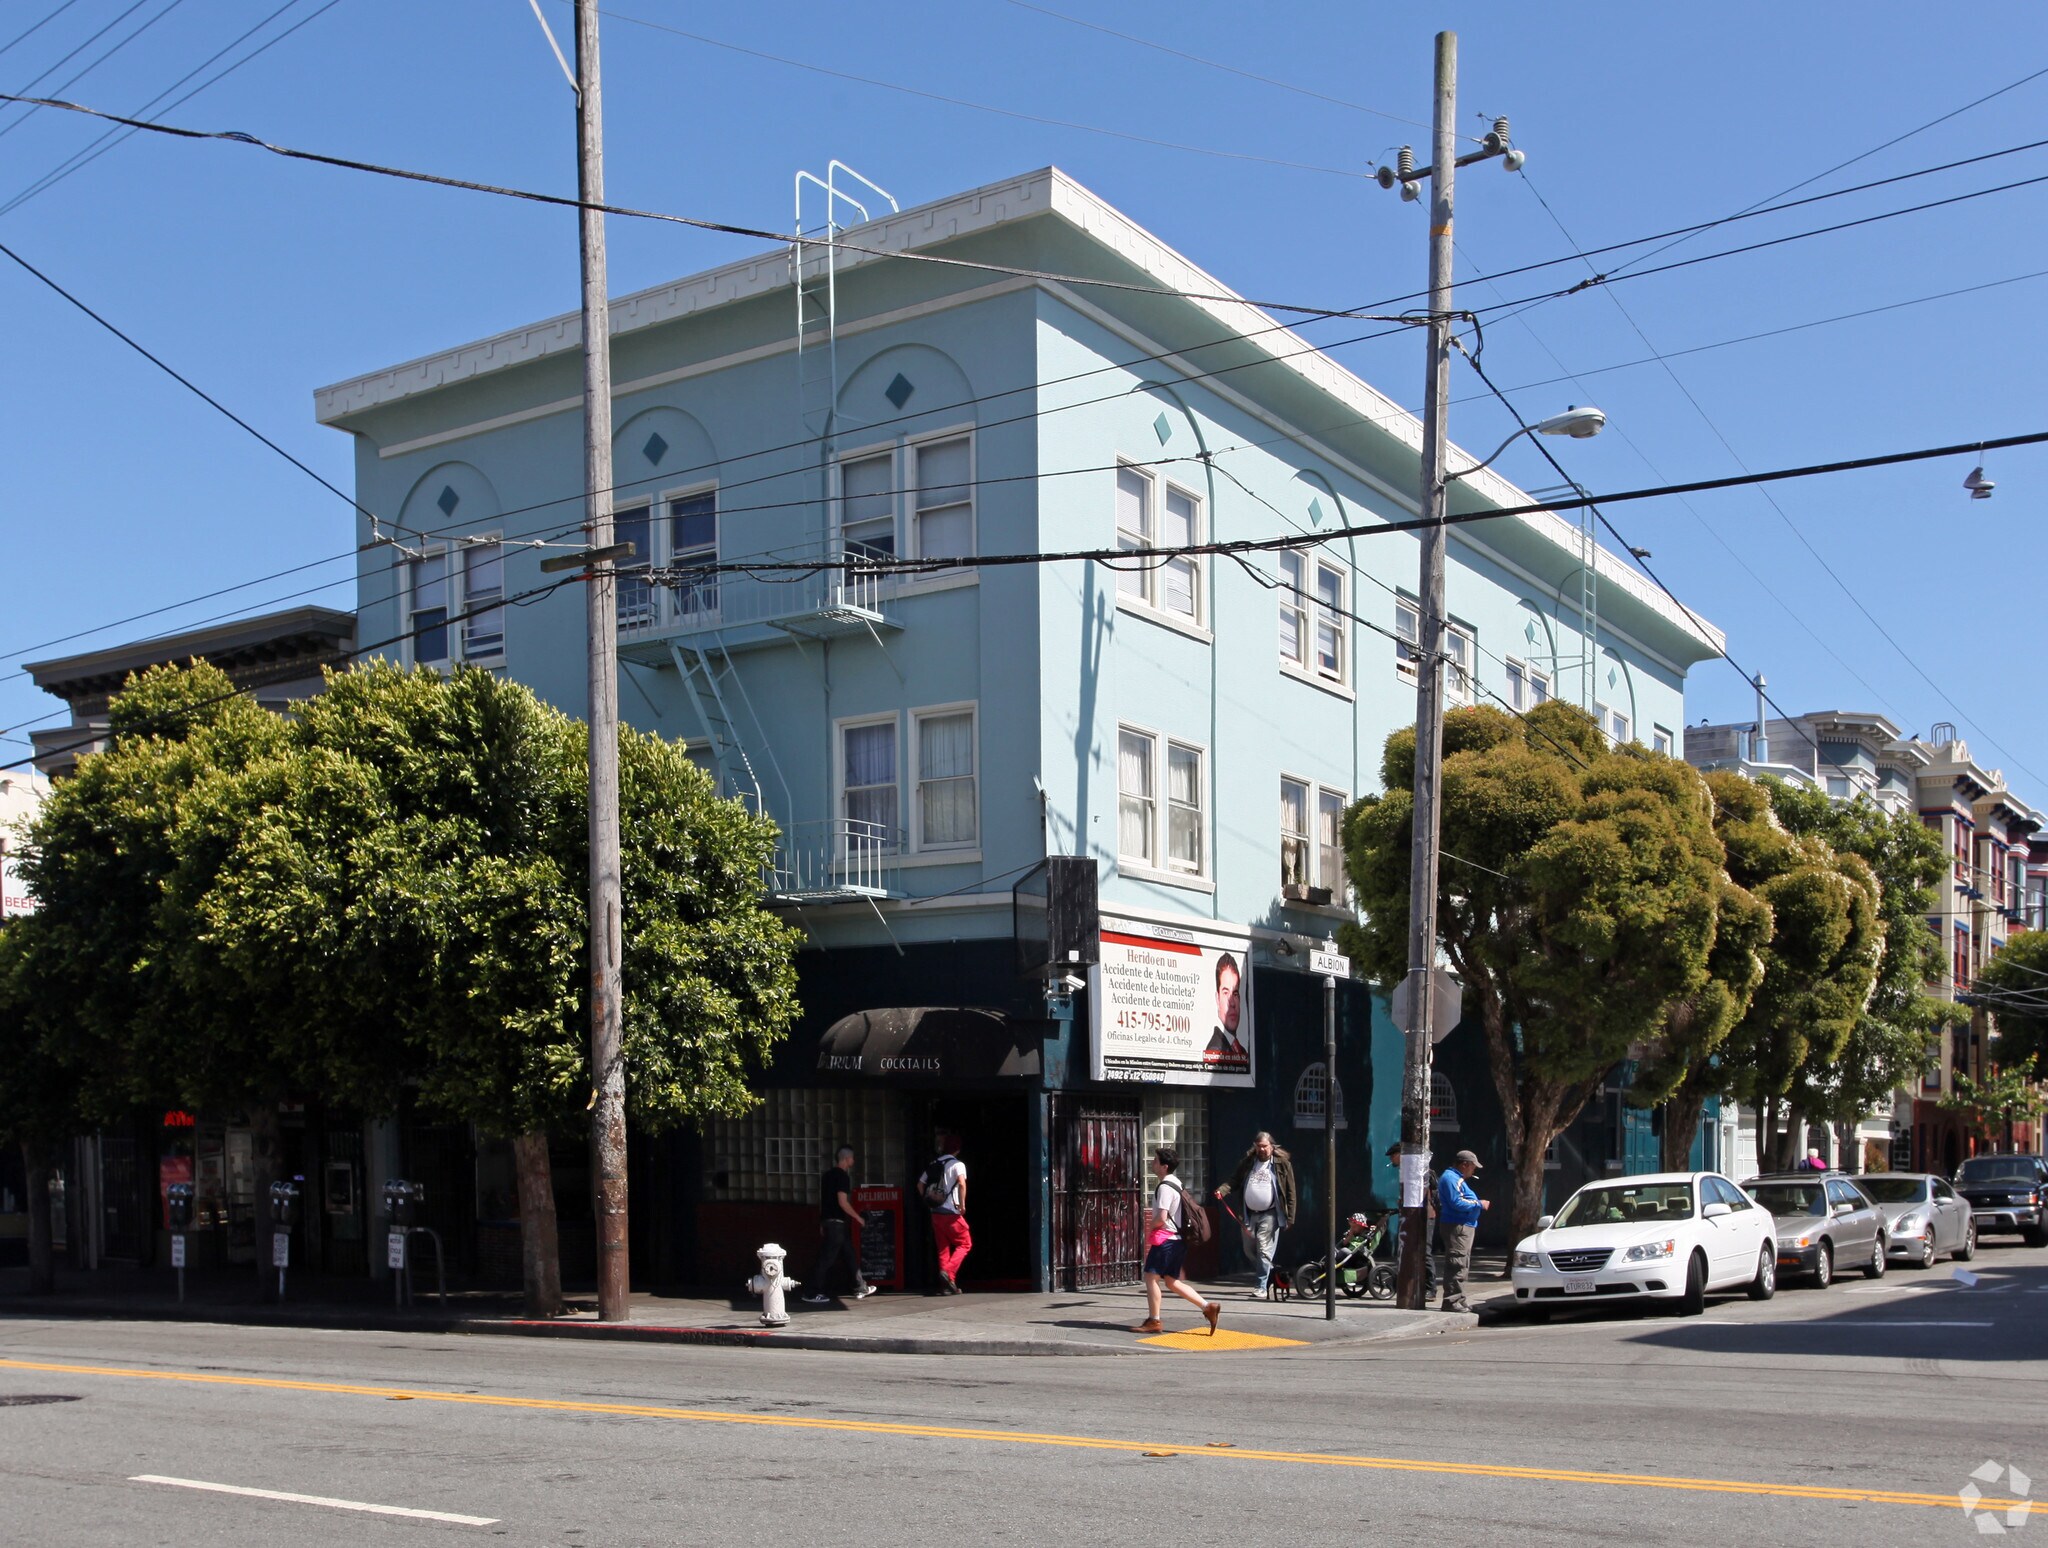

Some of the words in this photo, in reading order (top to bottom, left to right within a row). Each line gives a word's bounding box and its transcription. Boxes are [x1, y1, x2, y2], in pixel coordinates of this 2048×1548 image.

[1127, 949, 1155, 966] Herido
[1156, 956, 1165, 966] en
[1167, 958, 1177, 968] un
[1317, 956, 1345, 972] ALBION
[1102, 963, 1141, 979] Accidente
[1143, 967, 1153, 979] de
[1108, 978, 1148, 993] Accidente
[1149, 981, 1159, 993] de
[1160, 983, 1196, 998] bicicleta?
[1111, 992, 1150, 1007] Accidente
[1152, 996, 1162, 1008] de
[1162, 997, 1195, 1011] camión?
[1117, 1009, 1191, 1033] 415-795-2000
[1107, 1031, 1133, 1042] Oficinas
[1134, 1033, 1157, 1045] Legales
[1158, 1034, 1166, 1043] de
[1173, 1036, 1193, 1047] Chrisp
[880, 1057, 941, 1070] COCKTAILS
[858, 1191, 898, 1201] DELIRIUM
